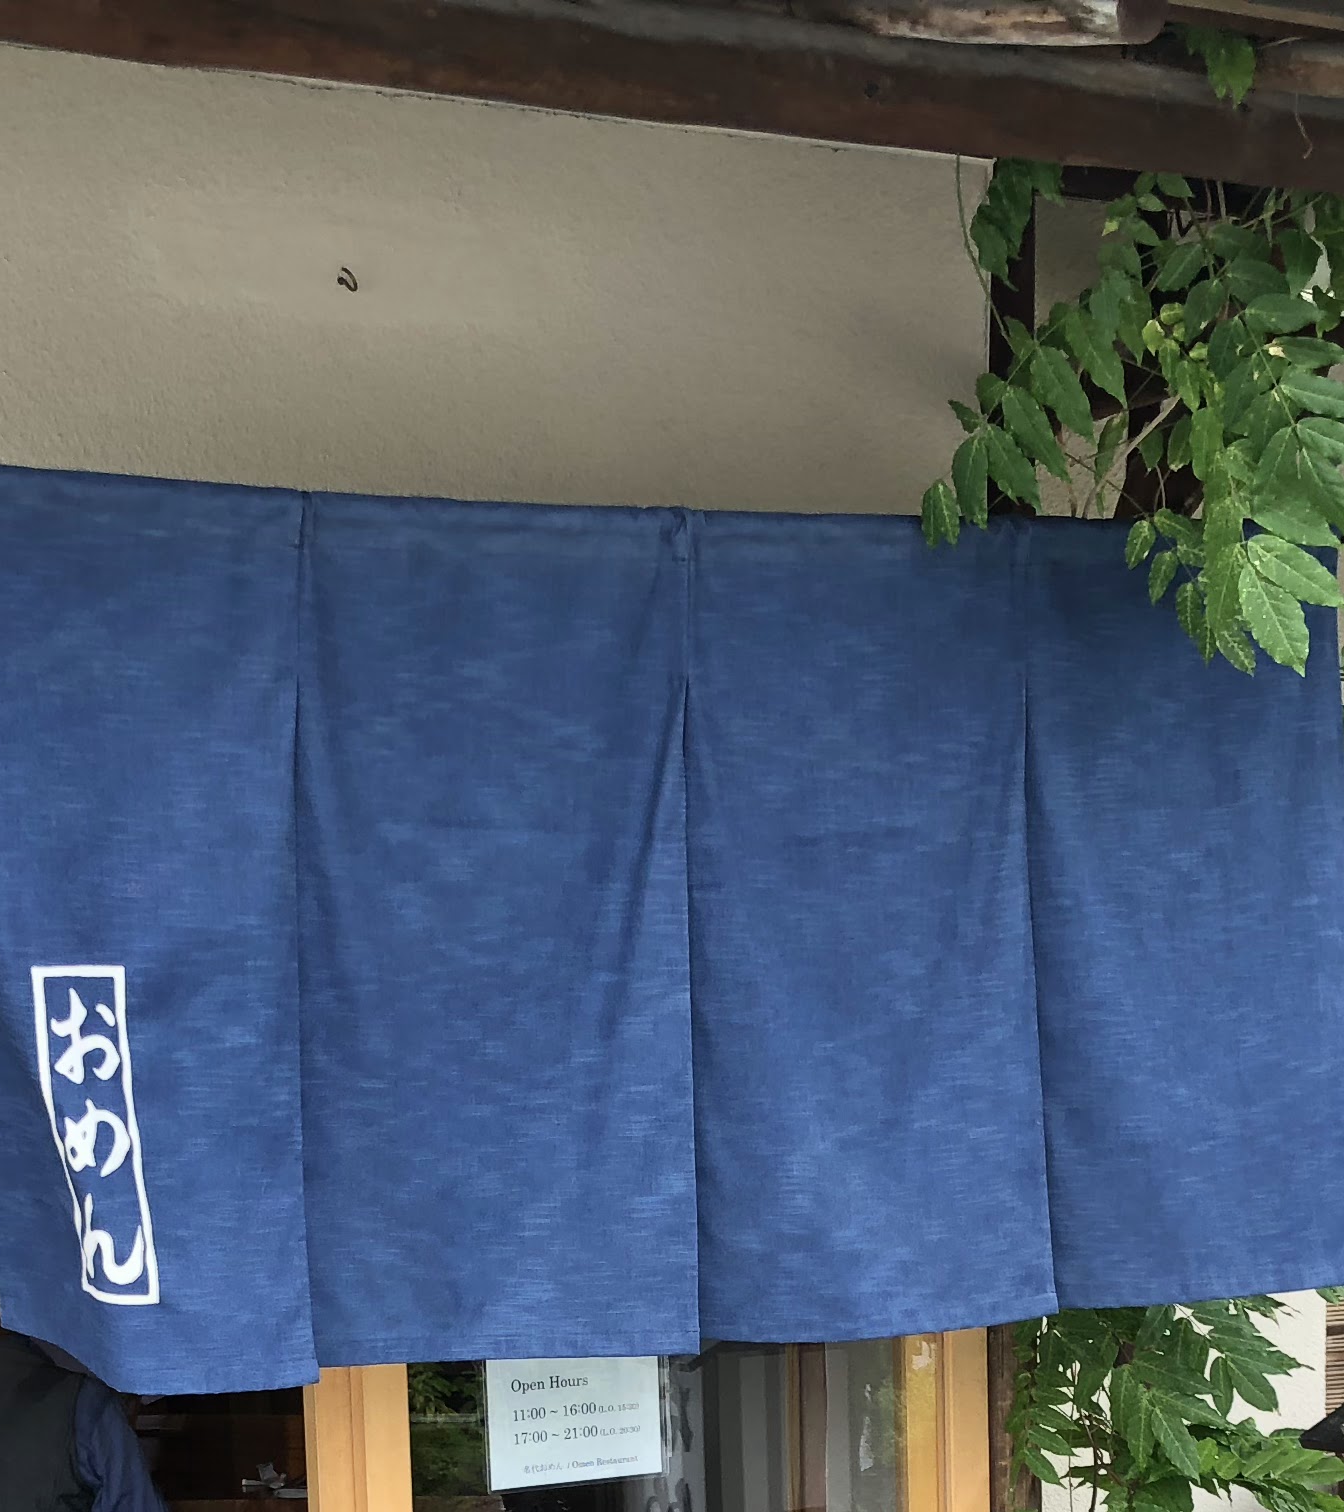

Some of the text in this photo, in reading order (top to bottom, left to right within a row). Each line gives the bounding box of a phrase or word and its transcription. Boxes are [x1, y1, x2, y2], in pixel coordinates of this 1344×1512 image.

[51, 987, 145, 1285] おめん
[511, 1375, 589, 1394] Open Hours
[513, 1407, 546, 1422] 11:00
[563, 1402, 597, 1417] 16:00
[514, 1430, 548, 1445] 17:00
[564, 1425, 598, 1440] 21:00
